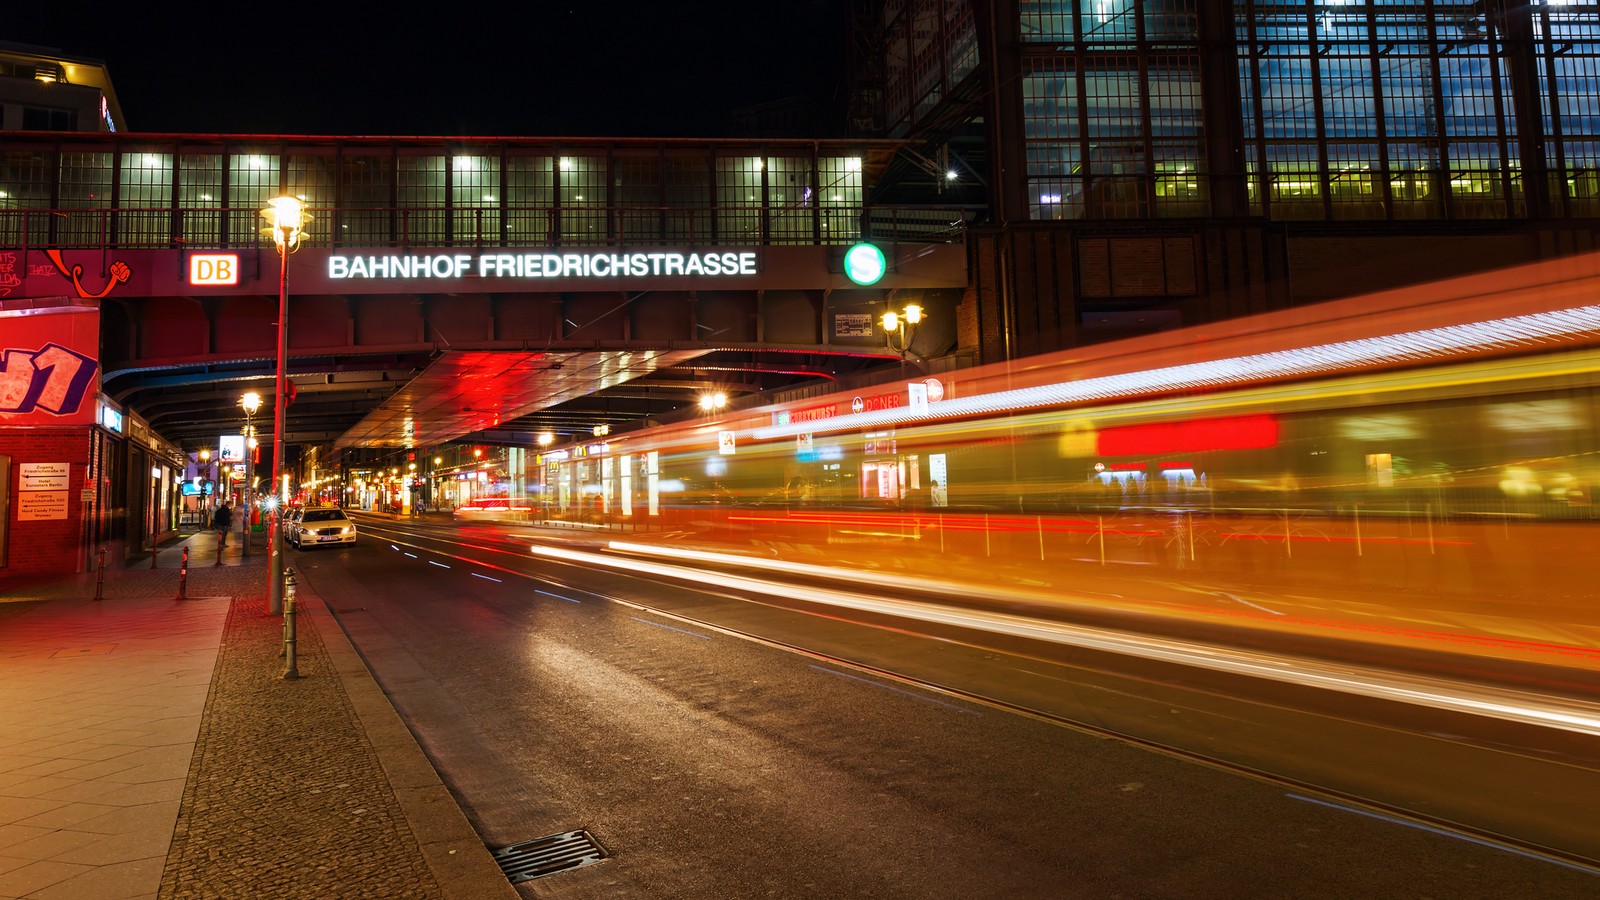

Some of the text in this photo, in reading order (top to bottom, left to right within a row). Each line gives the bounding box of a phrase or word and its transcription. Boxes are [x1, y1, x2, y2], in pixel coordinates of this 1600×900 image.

[197, 259, 232, 280] DB
[328, 252, 757, 279] BAHNHOF FRIEDRICHSTRASSE
[850, 245, 881, 283] S
[866, 395, 899, 412] DÖNER
[790, 405, 836, 424] CURRYWURST
